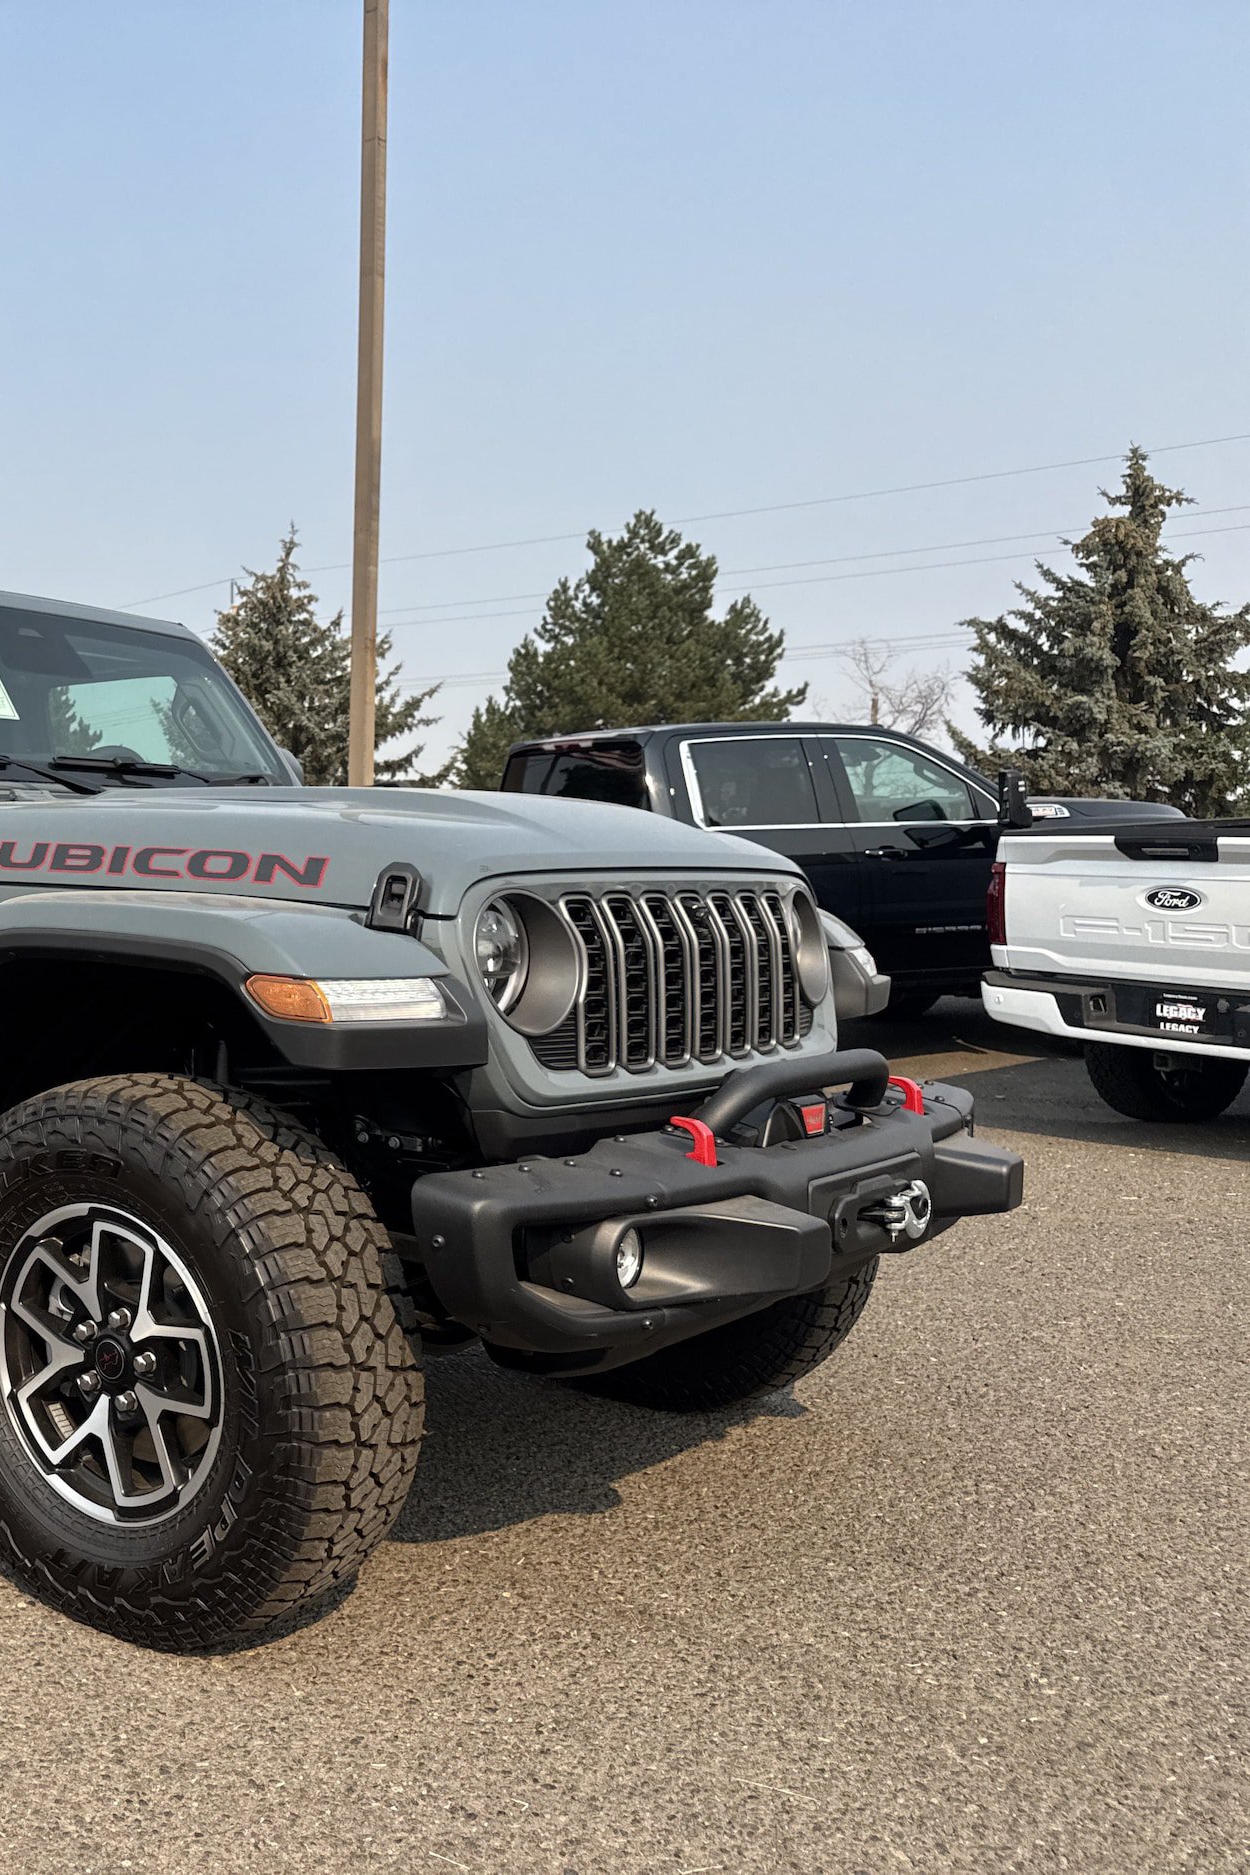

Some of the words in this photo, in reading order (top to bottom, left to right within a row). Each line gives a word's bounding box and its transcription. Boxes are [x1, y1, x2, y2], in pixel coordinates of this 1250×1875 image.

[1154, 890, 1190, 908] Ford
[1155, 1002, 1206, 1022] LEGACY
[1160, 1021, 1200, 1034] LEGACY
